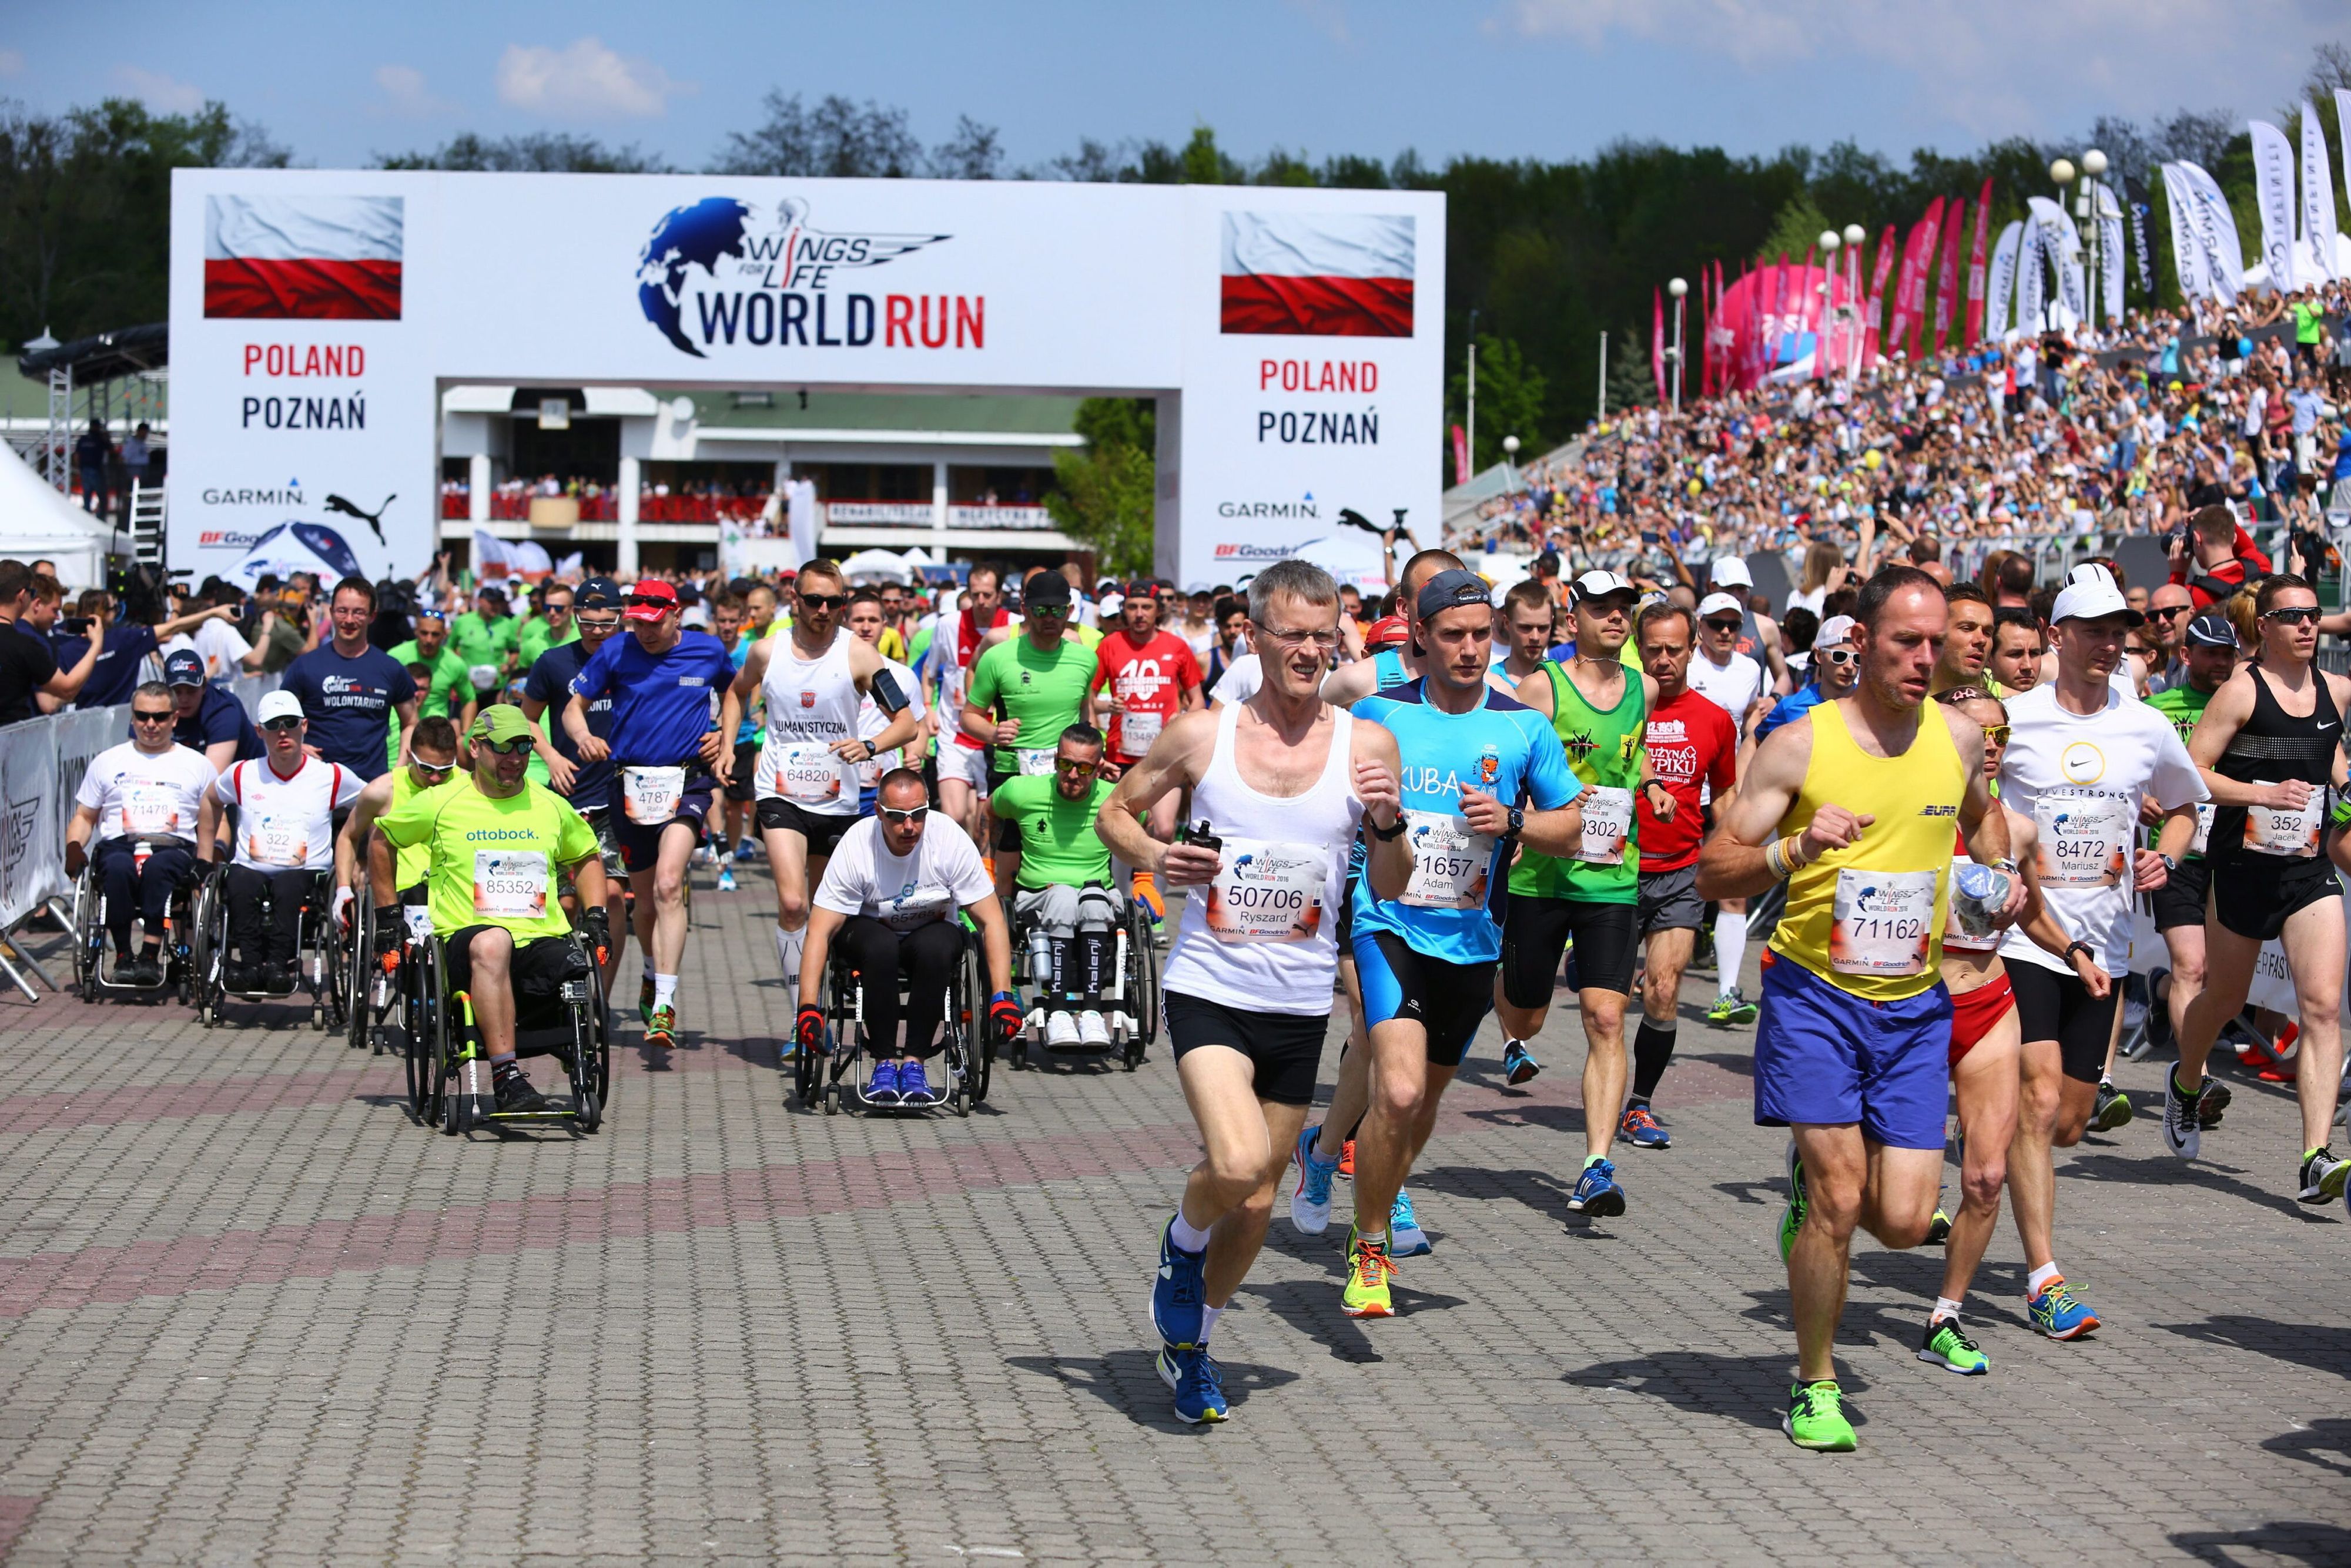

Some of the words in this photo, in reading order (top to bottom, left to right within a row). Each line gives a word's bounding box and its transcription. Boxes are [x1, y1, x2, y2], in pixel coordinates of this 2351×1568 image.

[744, 230, 872, 263] WINGS
[762, 264, 835, 290] LIFE
[696, 292, 875, 347] WORLD
[885, 295, 984, 349] RUN
[244, 344, 366, 377] POLAND
[1260, 359, 1378, 393] POLAND
[242, 390, 366, 430] POZNAŃ
[1258, 406, 1378, 444] POZNAŃ
[202, 488, 303, 505] GARMIN
[1218, 502, 1318, 518] GARMIN
[787, 769, 830, 782] 64820
[638, 790, 671, 804] 4787
[2036, 789, 2124, 799] LIVESTRONG
[2271, 815, 2302, 832] 352
[266, 833, 290, 846] 322
[466, 828, 539, 841] ottobock.
[2272, 833, 2296, 842] Jacek
[2056, 840, 2105, 858] 8472
[1255, 856, 1290, 868] WINGS
[2061, 860, 2099, 870] Mariusz
[1244, 873, 1264, 881] WORLD
[1423, 878, 1454, 889] Adam
[487, 880, 534, 894] 85352
[1228, 885, 1303, 909] 50706
[890, 909, 936, 924] 65765
[1240, 911, 1288, 926] Ryszard
[1853, 917, 1919, 939] 71162
[1834, 957, 1869, 966] GARMIN
